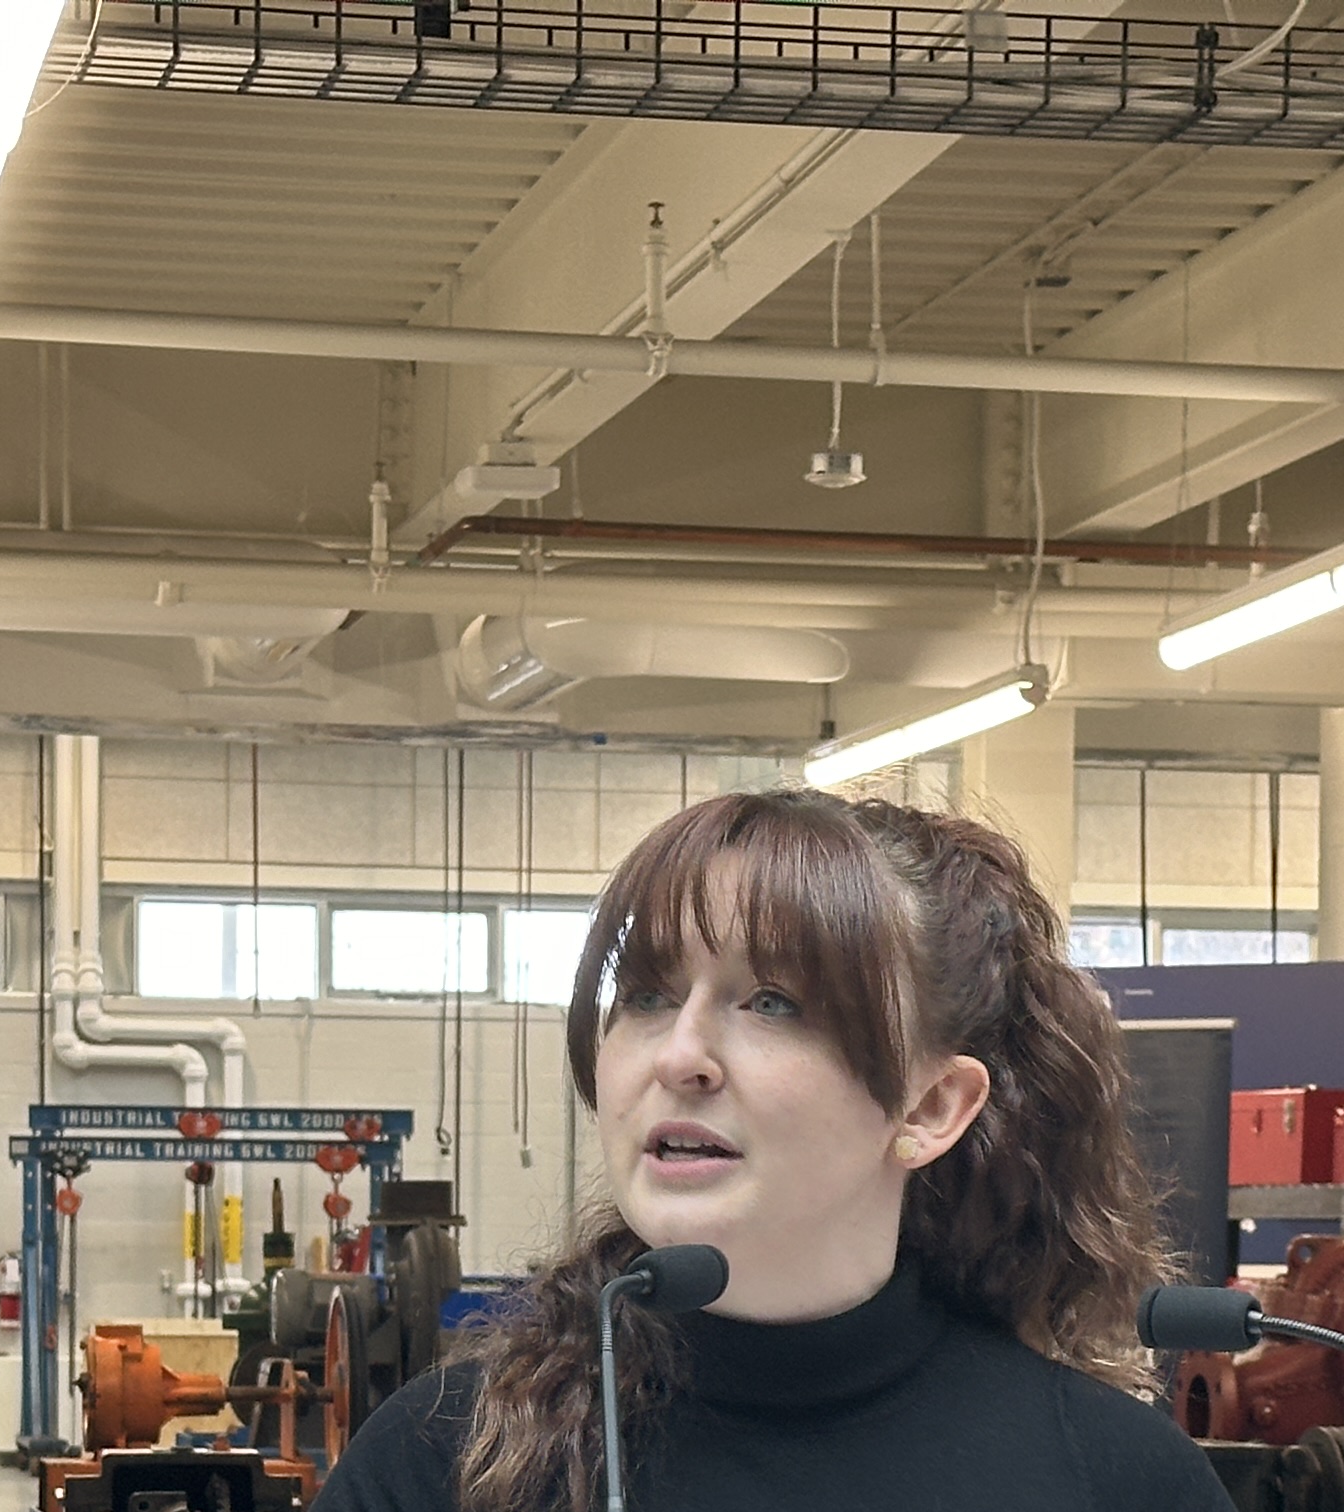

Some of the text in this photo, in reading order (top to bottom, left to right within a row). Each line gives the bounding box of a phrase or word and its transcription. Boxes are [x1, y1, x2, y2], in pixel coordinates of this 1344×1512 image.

[60, 1110, 166, 1126] INDUSTRIAL
[301, 1112, 345, 1129] 2000
[154, 1141, 235, 1159] TRAINING
[284, 1142, 327, 1160] 200
